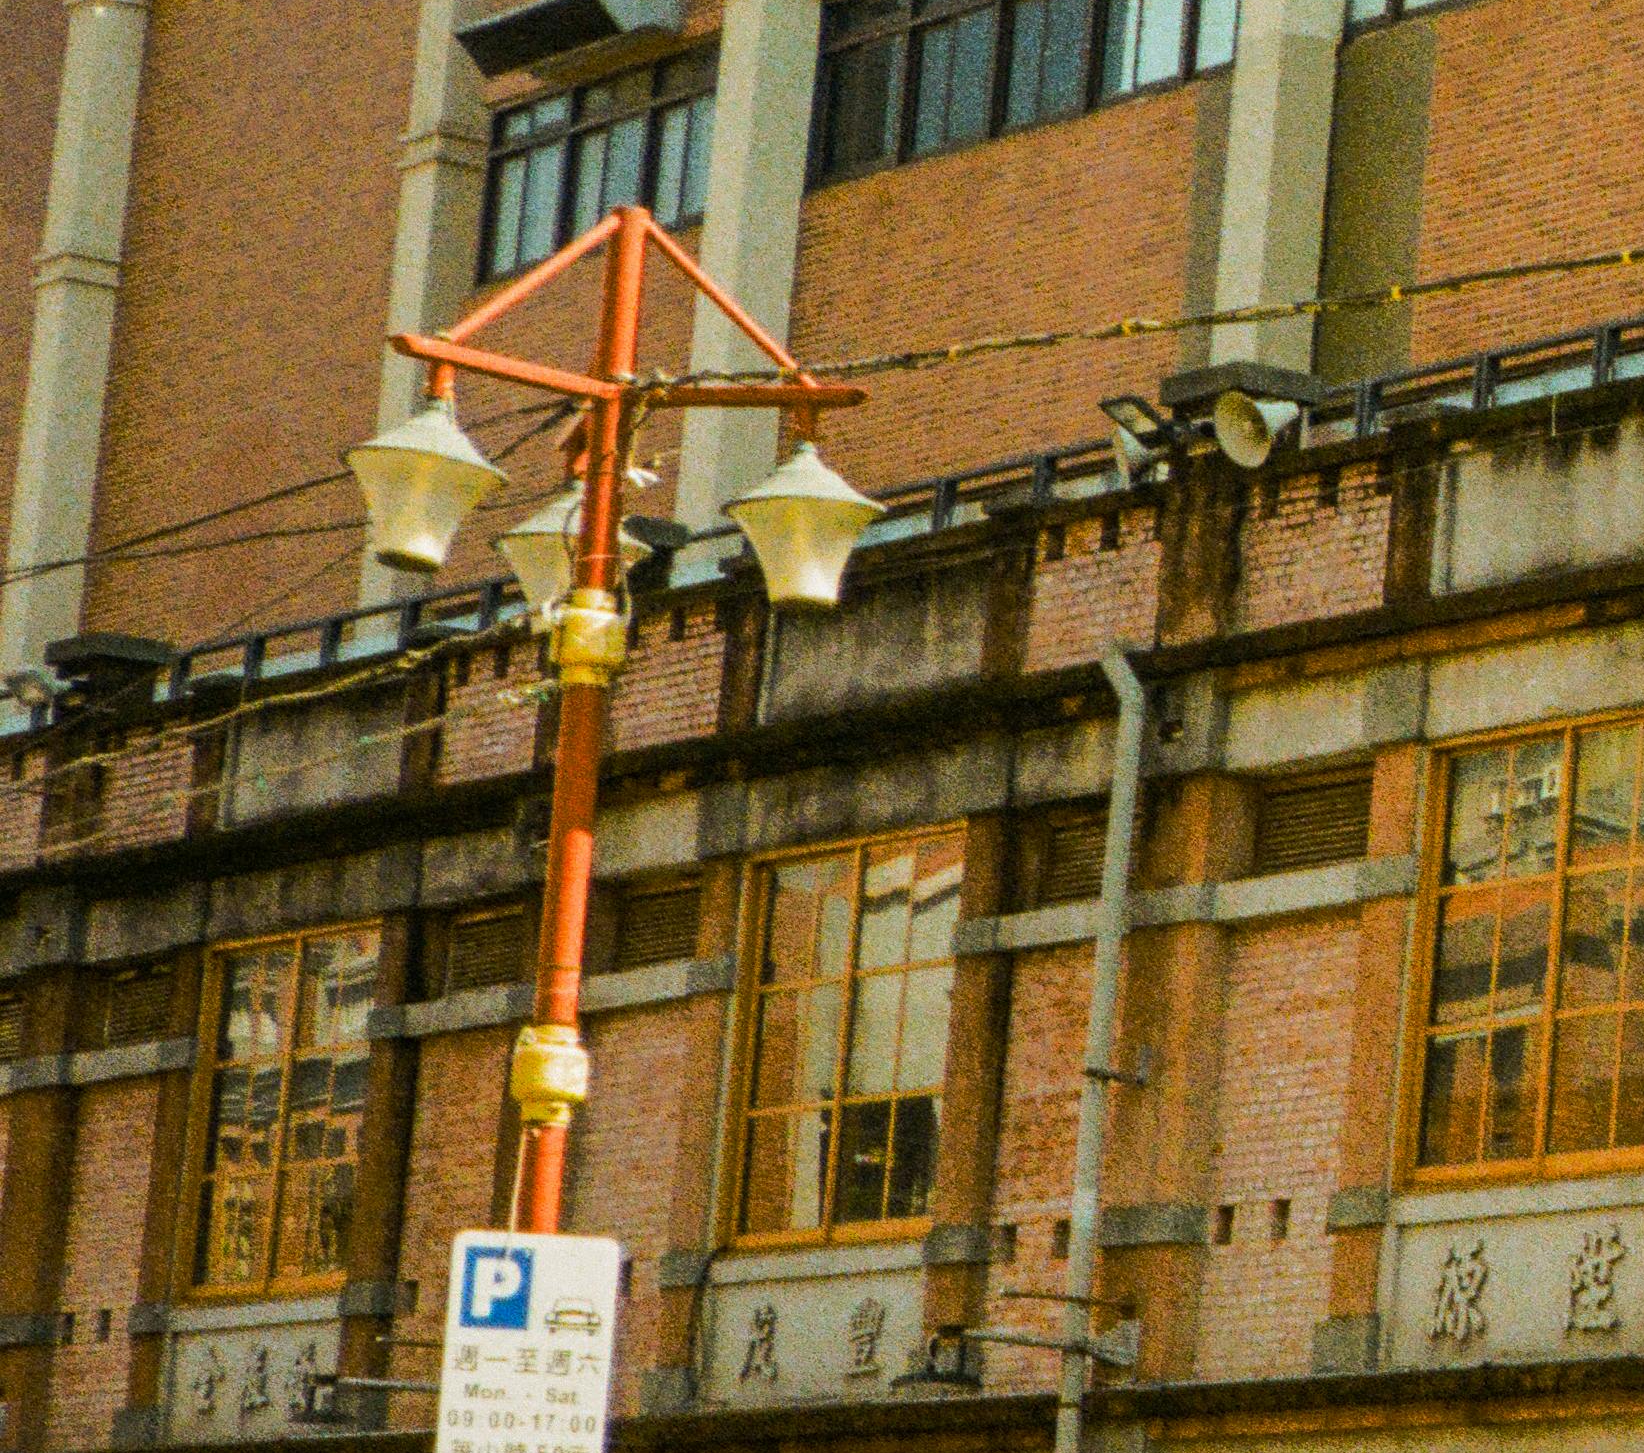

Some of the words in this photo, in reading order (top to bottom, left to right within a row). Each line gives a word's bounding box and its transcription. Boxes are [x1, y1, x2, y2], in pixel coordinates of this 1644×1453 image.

[470, 1254, 522, 1319] P
[454, 1345, 600, 1376] 週一至週六
